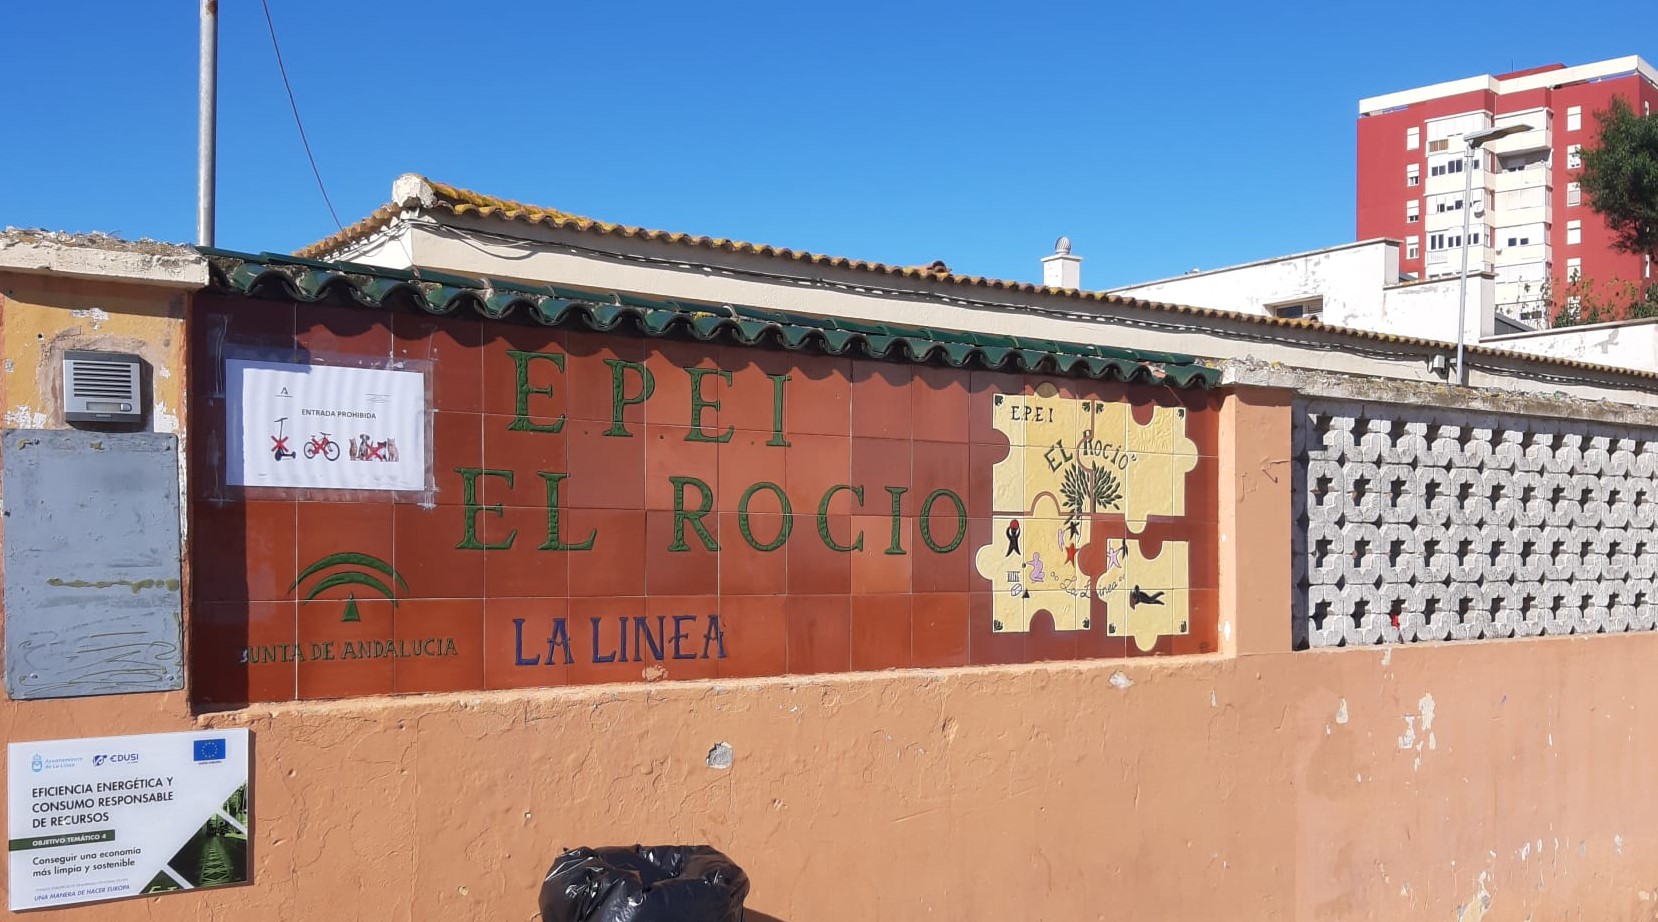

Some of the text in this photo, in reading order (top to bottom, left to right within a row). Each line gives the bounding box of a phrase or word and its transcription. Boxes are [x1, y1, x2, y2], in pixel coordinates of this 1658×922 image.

[301, 408, 377, 419] ENTRADA PROHIBIDA
[454, 466, 968, 556] EL ROCIO
[512, 614, 728, 666] LA LINEA
[239, 637, 459, 664] JUNTA DE ANDALUCIA
[32, 777, 174, 798] EFICIENCIA ENERGÉTICA Y
[32, 791, 174, 813] CONSUMO RESPONSABLE
[32, 812, 109, 829] DE RECURSOS
[32, 838, 66, 847] OBJETIVO
[67, 833, 100, 843] TEMÁTICO
[32, 847, 142, 866] Conseguir una economía
[32, 858, 136, 878] más limpia y sostenible
[49, 891, 76, 900] MANERA
[106, 884, 130, 893] EUROPA
